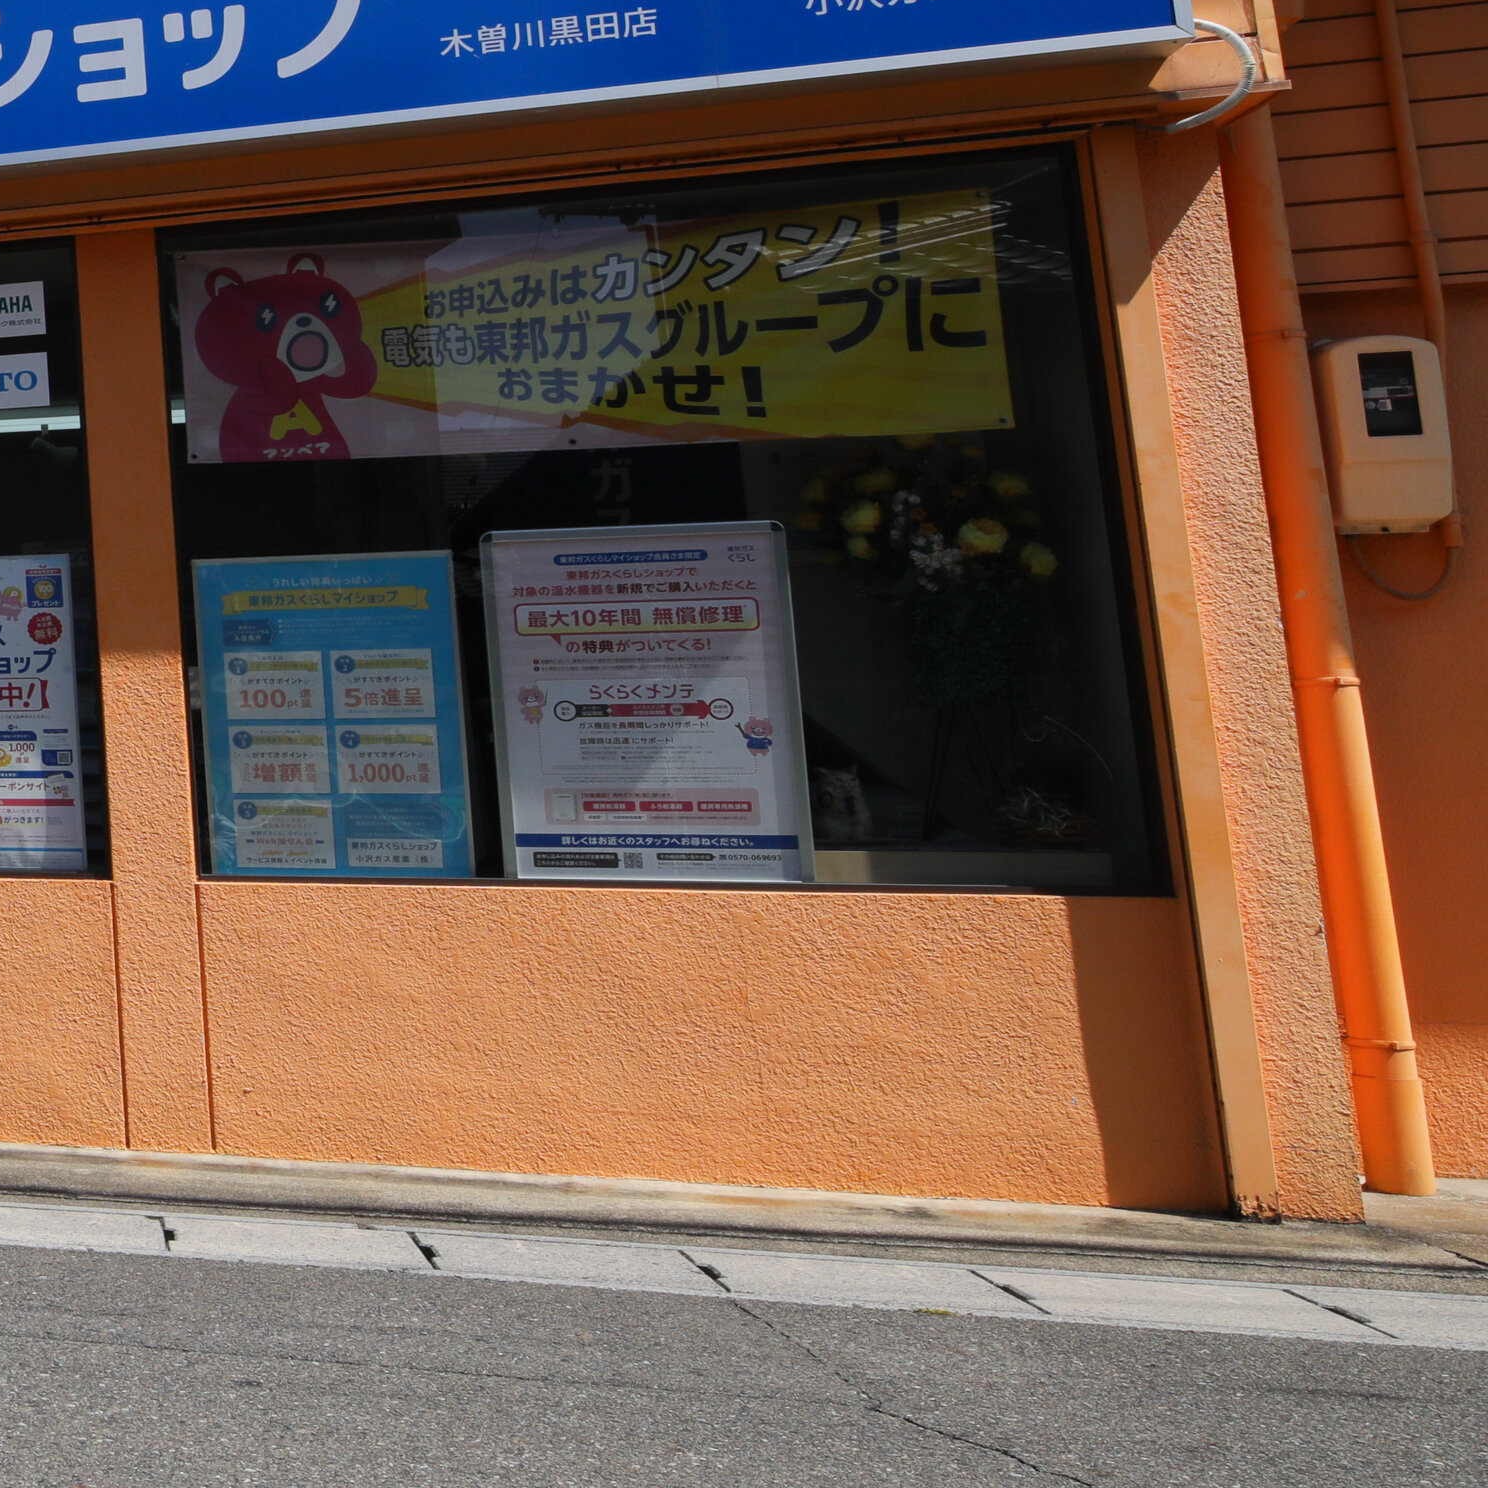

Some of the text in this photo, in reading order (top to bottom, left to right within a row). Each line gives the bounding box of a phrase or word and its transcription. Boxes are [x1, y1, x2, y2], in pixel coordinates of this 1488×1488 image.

[439, 6, 659, 58] 木曽川黒田店
[379, 274, 987, 370] 電気も東邦ガスグループに
[497, 363, 769, 420] おまかせ!
[262, 442, 331, 459] アンベア
[726, 553, 756, 563] くらし
[566, 567, 697, 581] 東邦ガスくらしショップで
[512, 579, 758, 598] 対象の温水機器を新規でご購入いただくと
[248, 590, 400, 608] 東邦ガスくらしマイショップ
[527, 605, 745, 629] 最大10年間 無償修理
[34, 627, 59, 640] 無料
[566, 637, 713, 655] の特典がついてくる!
[239, 688, 299, 709] 100pt
[343, 687, 425, 708] 5倍進呈
[589, 684, 695, 700] らくらくメンテ
[578, 721, 710, 730] ガス機器を長期間しっかりサポート!
[8, 743, 36, 753] 1,000
[252, 763, 303, 783] 増額
[347, 763, 417, 783] 1,000pt
[351, 842, 438, 851] 東邦ガスくらしショップ
[561, 835, 755, 847] 詳しくはお近くのスタッフへお尋ねください。
[727, 854, 783, 862] 0570-069693
